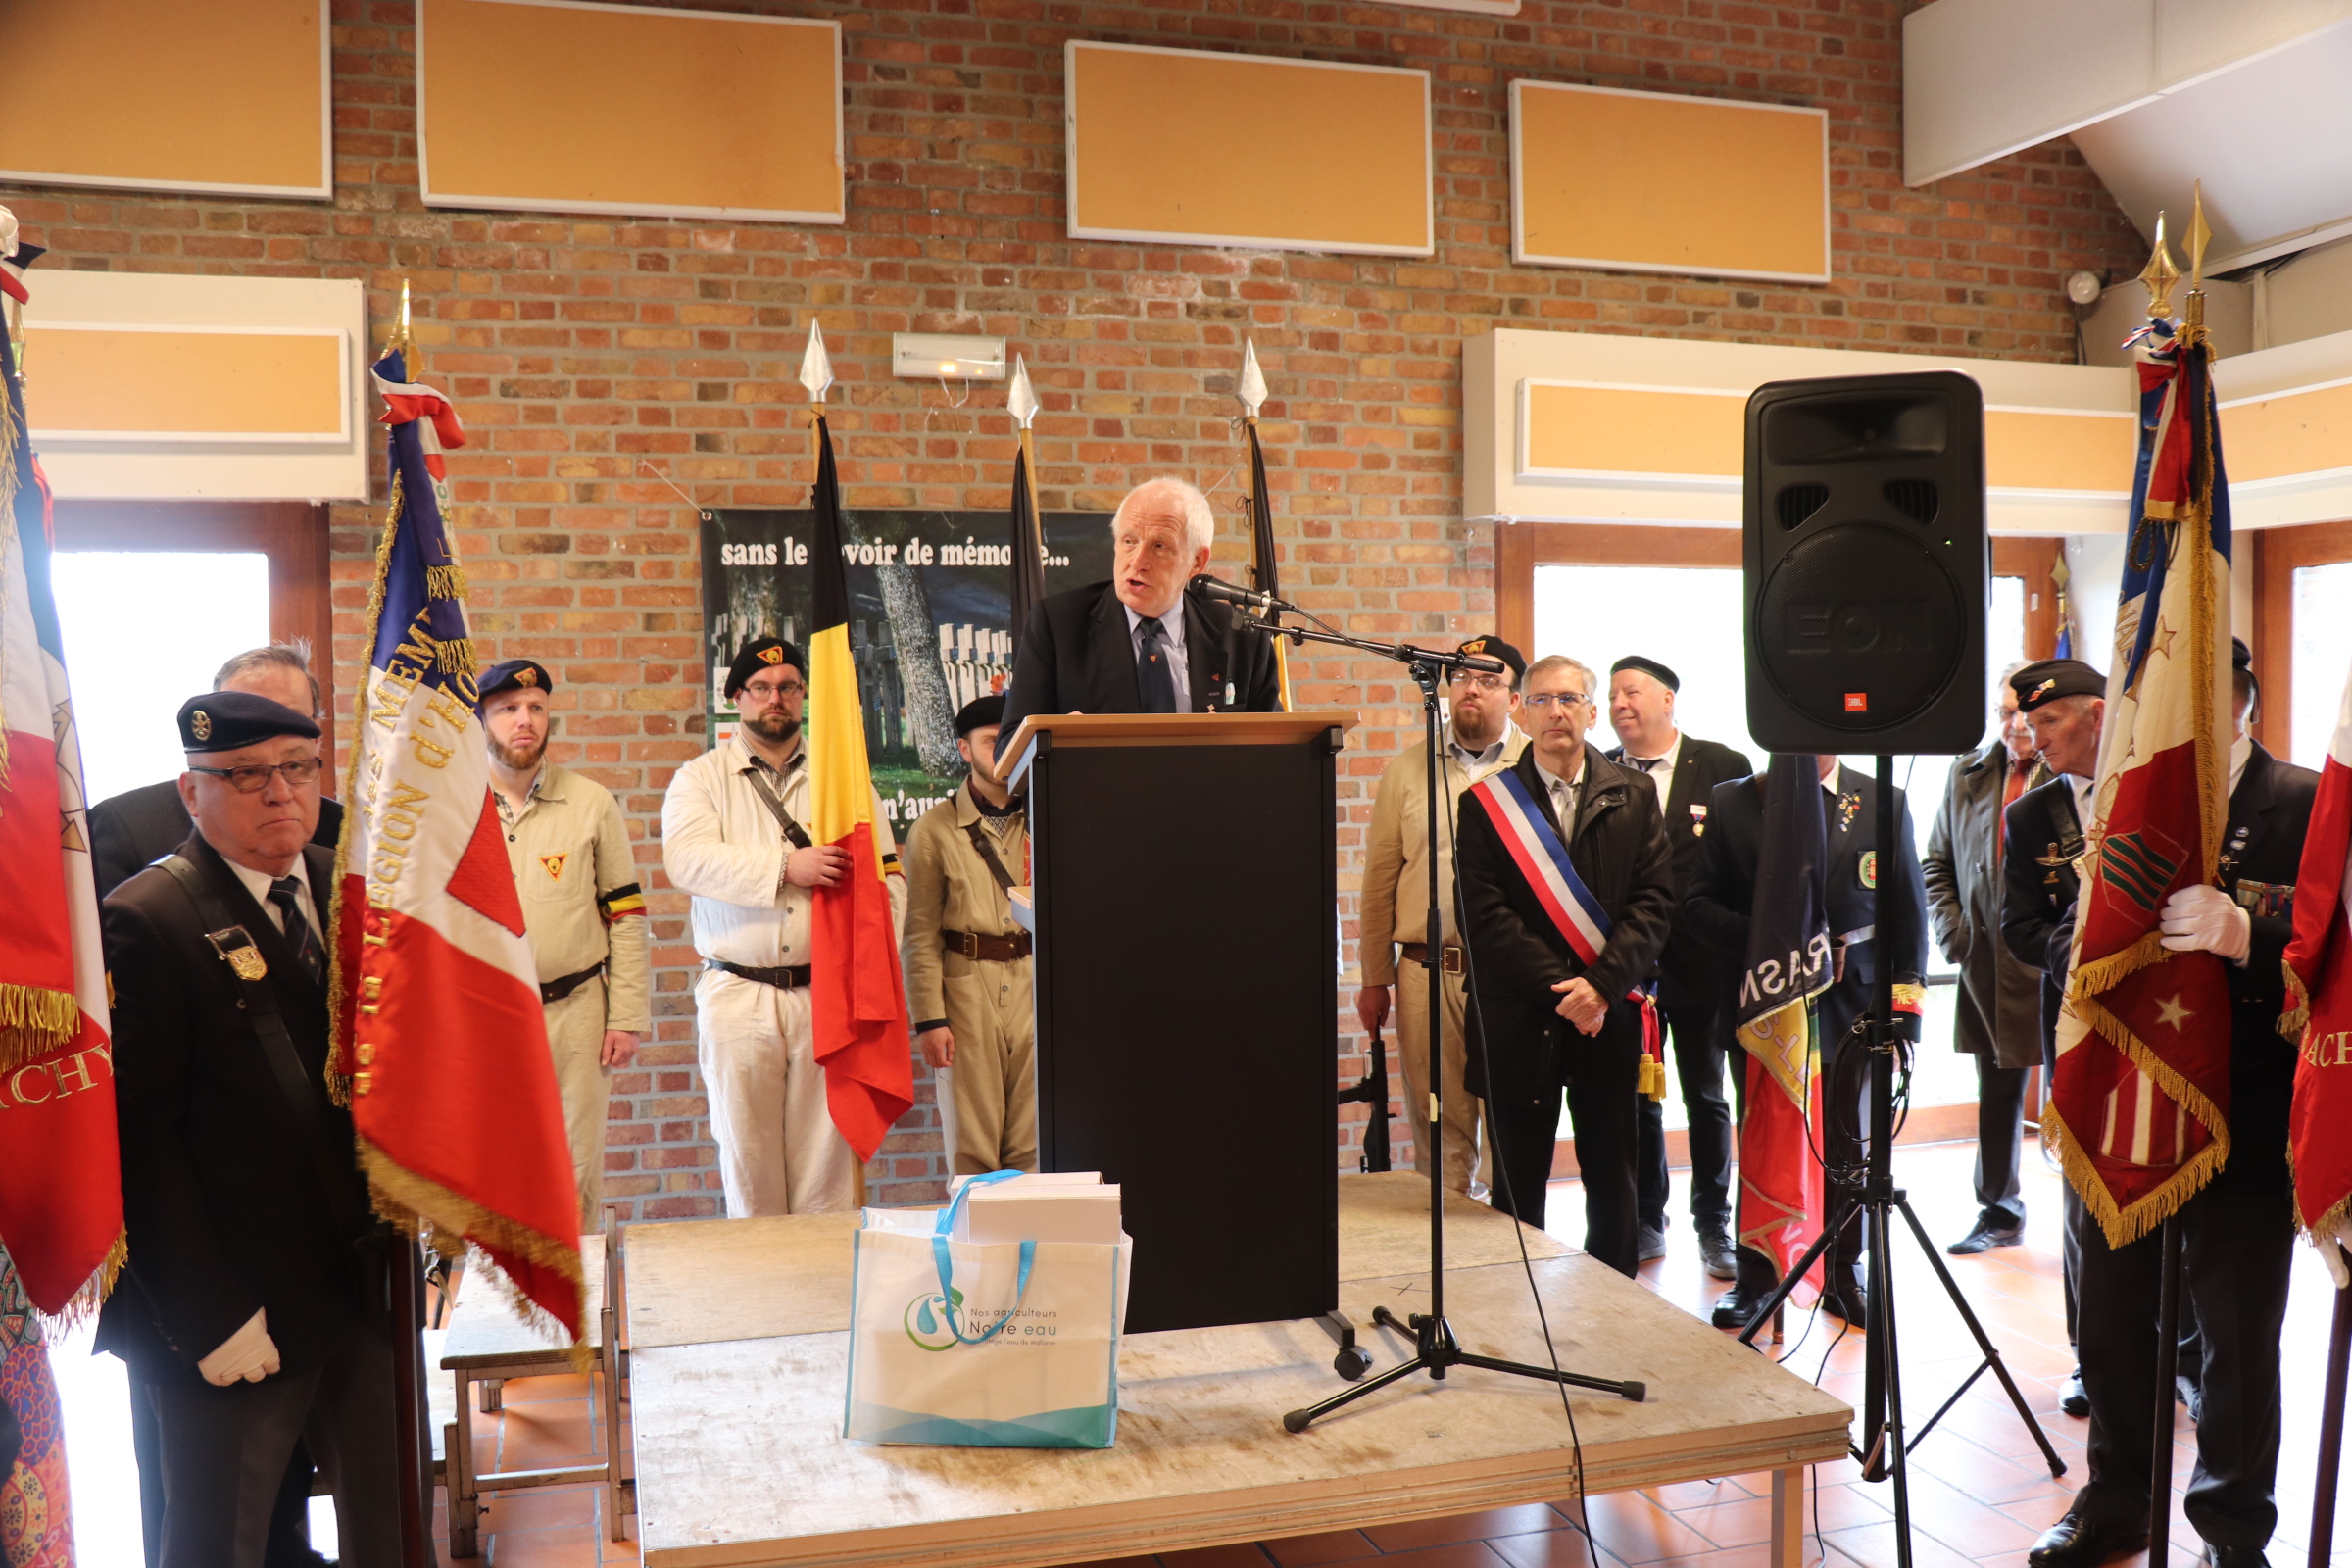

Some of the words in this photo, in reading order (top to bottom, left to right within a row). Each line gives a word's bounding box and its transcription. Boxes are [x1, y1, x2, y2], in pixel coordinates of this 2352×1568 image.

[721, 543, 778, 566] sans
[784, 536, 808, 566] le
[842, 537, 898, 566] voir
[904, 536, 934, 566] de
[940, 535, 1070, 567] mémoe...
[970, 1308, 990, 1317] Nos
[970, 1320, 1017, 1335] Nore
[1024, 1325, 1057, 1336] eau
